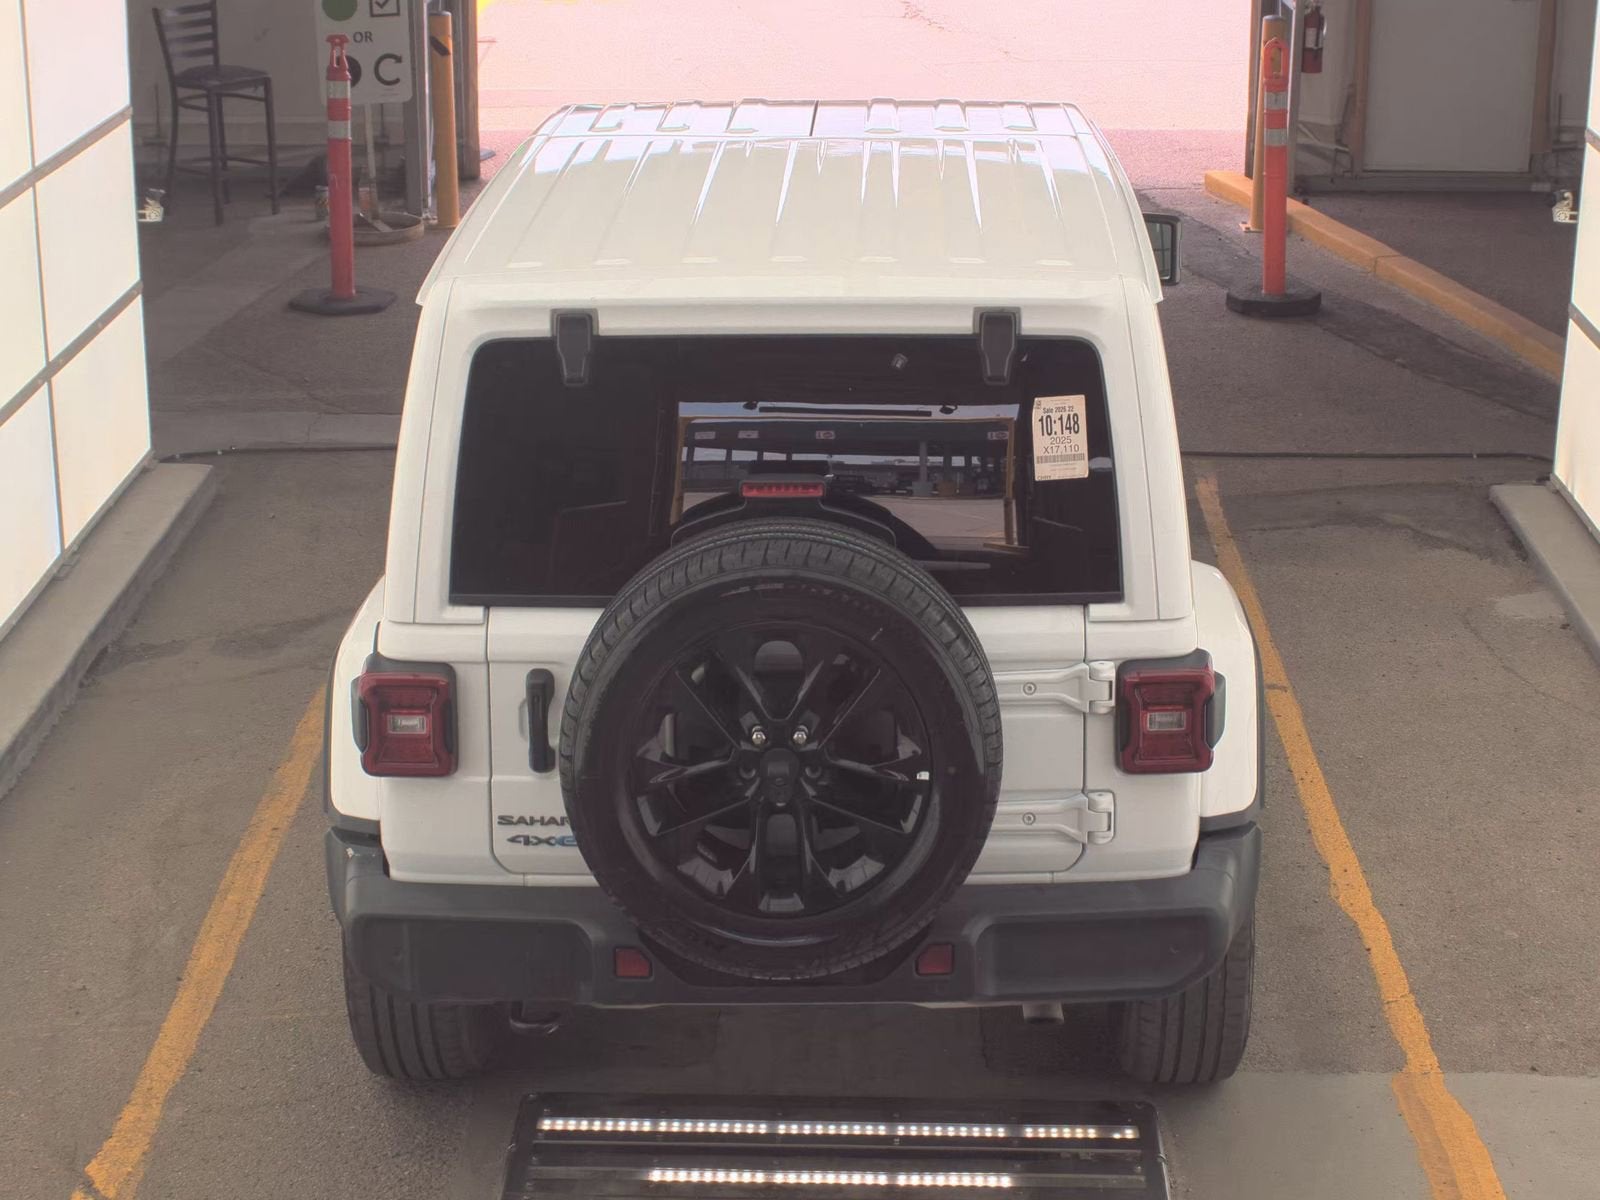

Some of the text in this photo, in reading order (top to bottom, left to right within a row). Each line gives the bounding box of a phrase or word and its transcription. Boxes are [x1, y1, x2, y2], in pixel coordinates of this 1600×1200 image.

[353, 31, 373, 43] OR
[1038, 413, 1080, 436] 10:148
[1050, 436, 1072, 445] 2025
[497, 815, 570, 826] SAHAR
